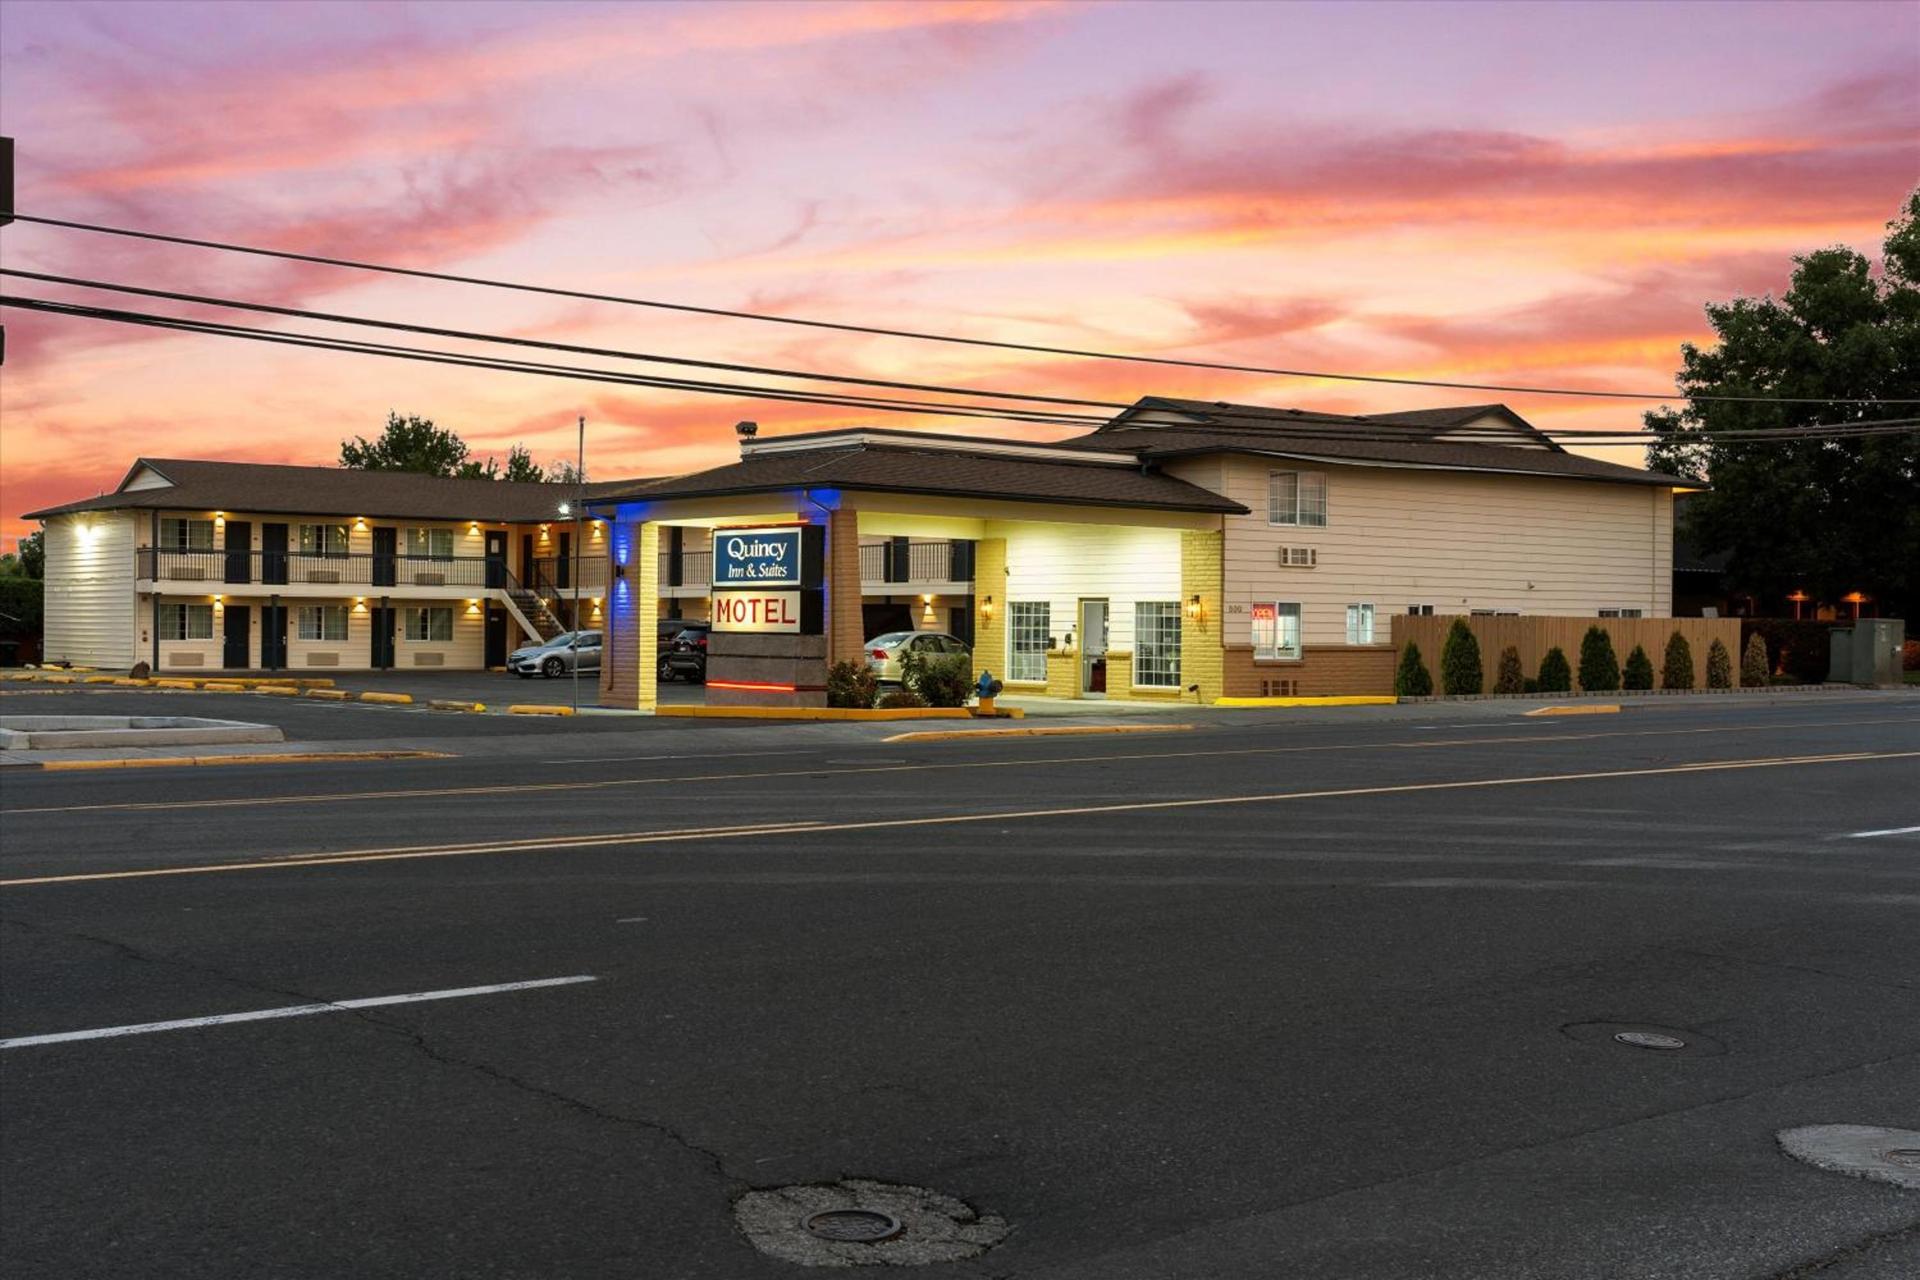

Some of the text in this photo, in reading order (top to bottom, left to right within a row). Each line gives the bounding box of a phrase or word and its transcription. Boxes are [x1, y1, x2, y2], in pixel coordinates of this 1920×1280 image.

[727, 537, 787, 561] Quincy
[728, 562, 788, 578] Inn & Suites
[716, 598, 797, 624] MOTEL
